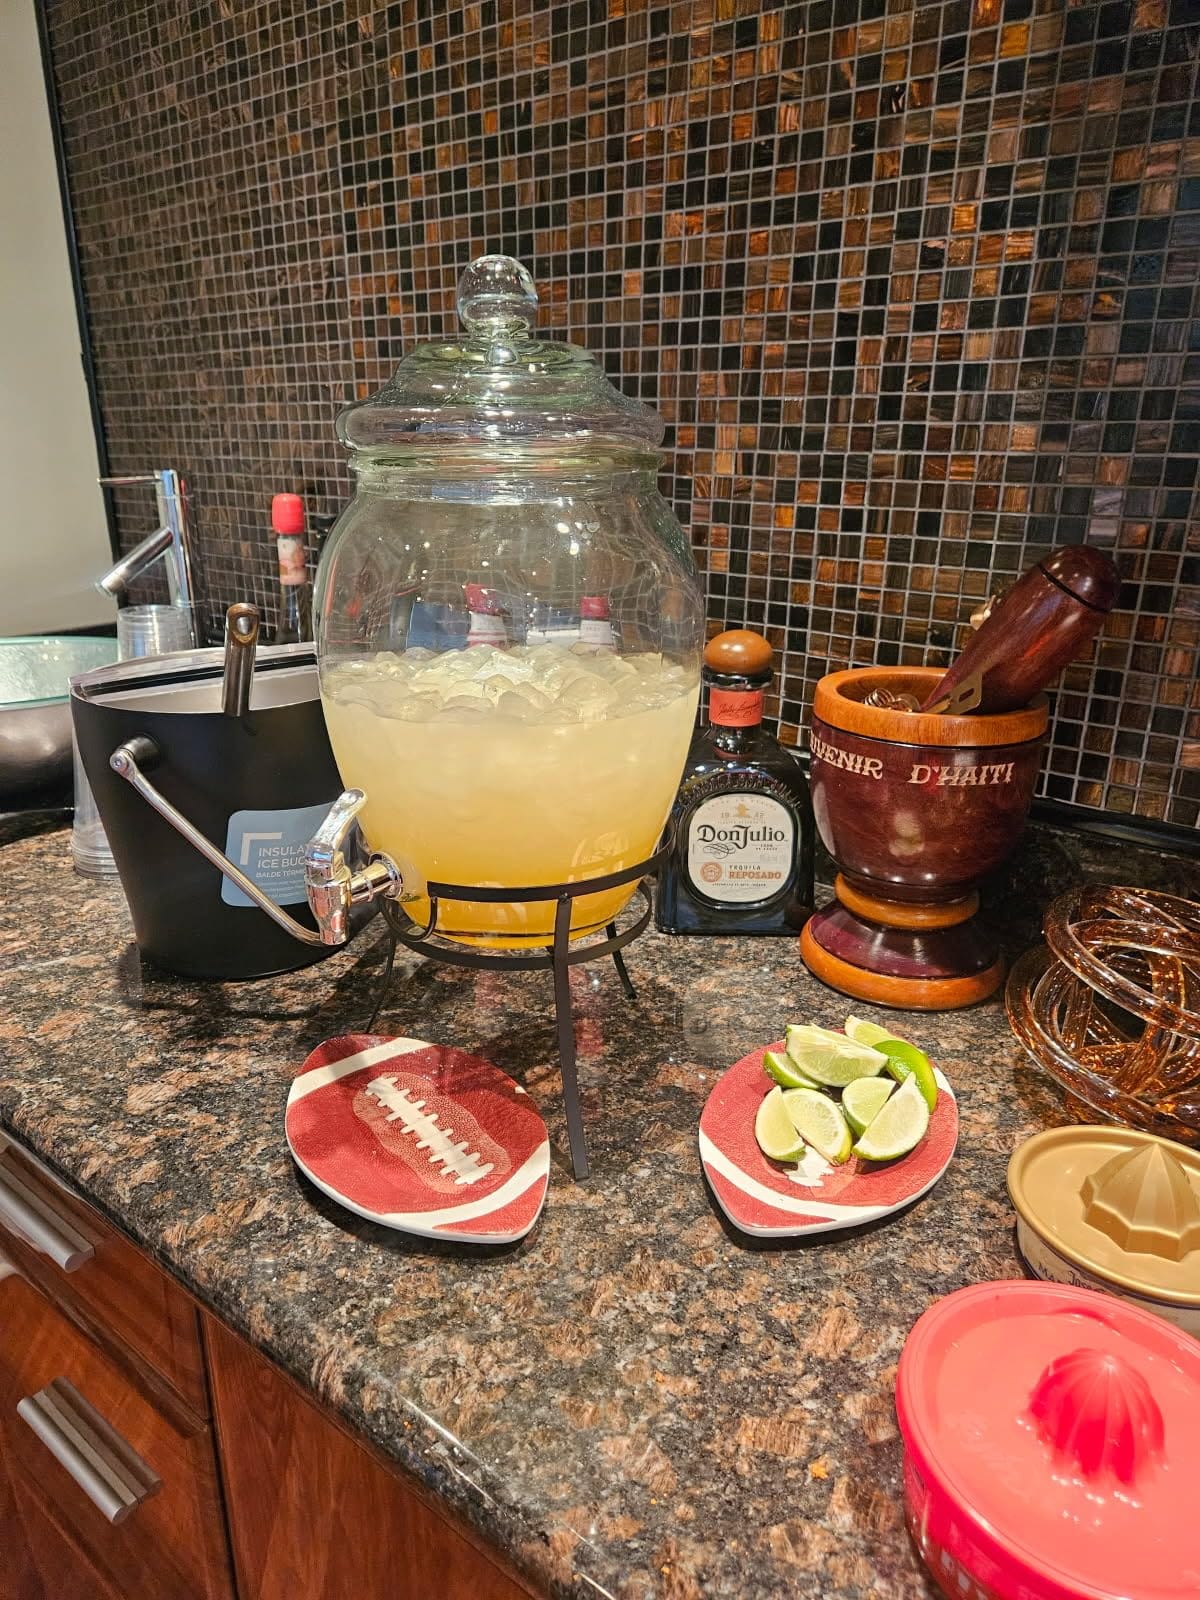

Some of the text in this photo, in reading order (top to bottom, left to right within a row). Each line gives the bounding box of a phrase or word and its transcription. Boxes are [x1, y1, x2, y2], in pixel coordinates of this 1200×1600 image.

[810, 729, 1016, 786] UVENIR D'HAITI
[258, 845, 305, 857] INSULA
[257, 856, 305, 869] ICE BUC
[728, 871, 782, 880] REPOSADO
